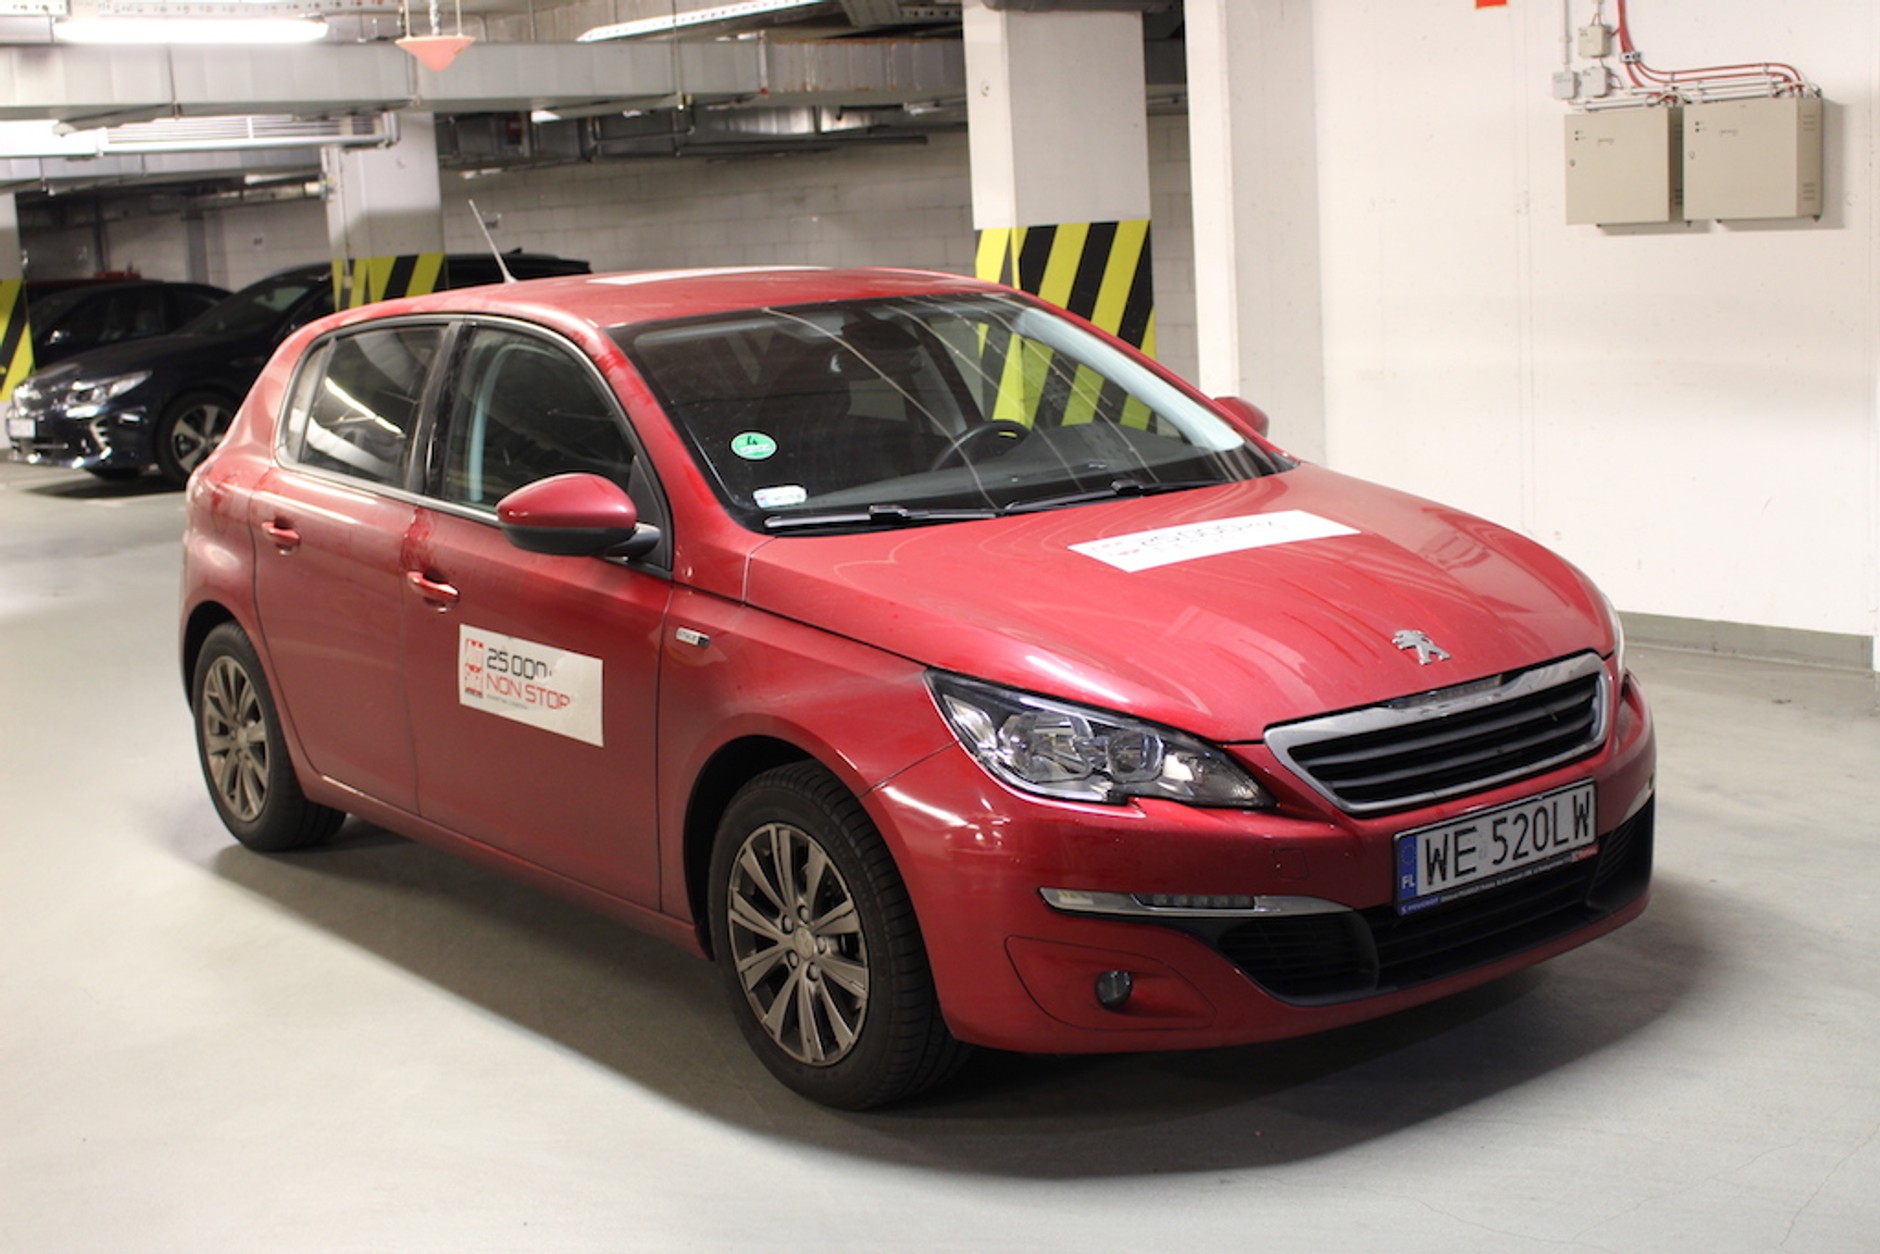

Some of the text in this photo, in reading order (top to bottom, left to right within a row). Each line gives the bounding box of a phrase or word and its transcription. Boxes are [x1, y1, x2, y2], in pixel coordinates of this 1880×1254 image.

[487, 648, 509, 673] 25
[486, 672, 522, 698] NON
[525, 683, 571, 711] STOP
[1425, 826, 1478, 886] WE
[1492, 791, 1591, 866] 520LW
[1401, 875, 1416, 890] PL
